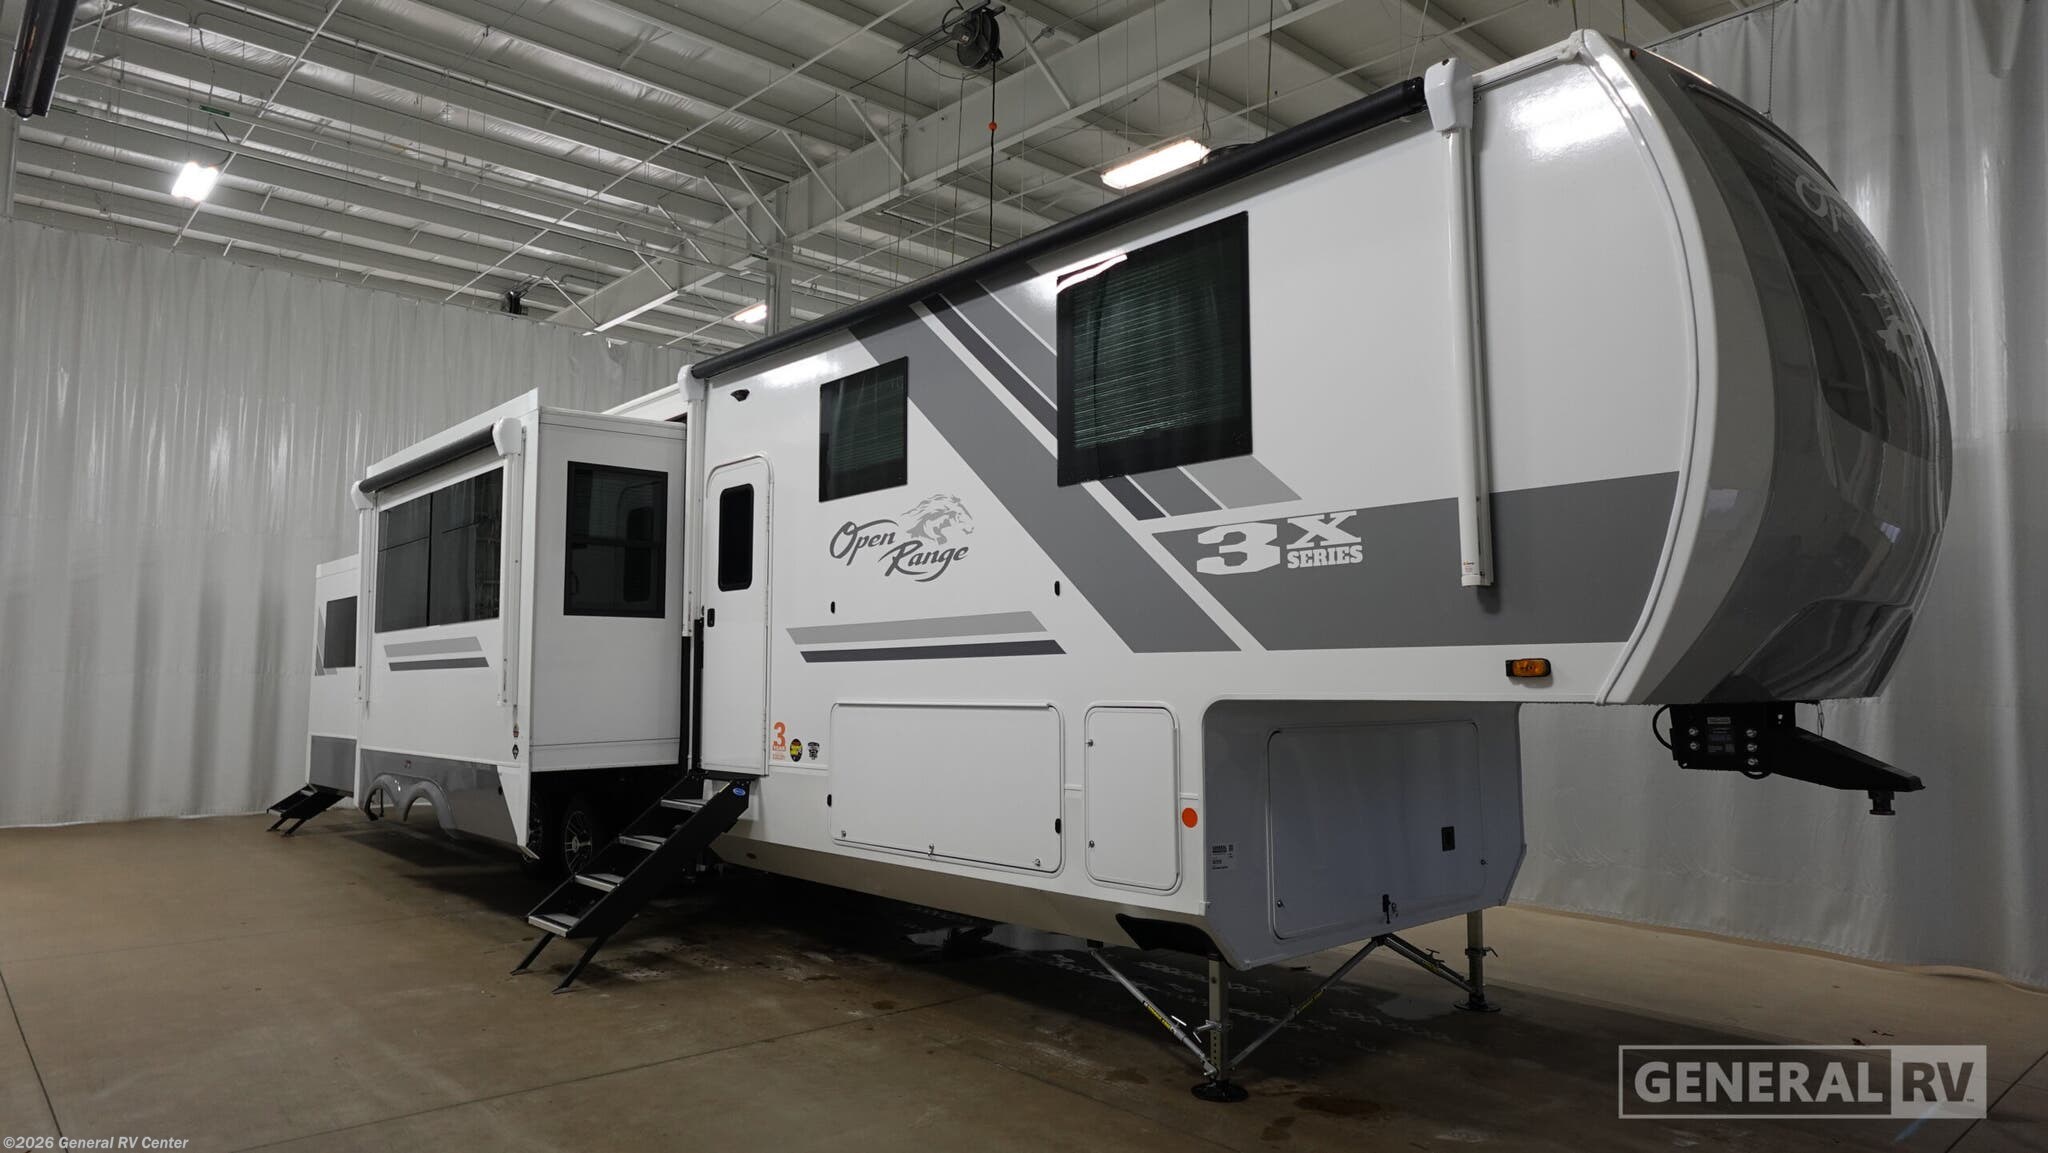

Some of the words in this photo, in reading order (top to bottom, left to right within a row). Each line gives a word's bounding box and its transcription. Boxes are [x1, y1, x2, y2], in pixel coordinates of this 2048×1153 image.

[829, 519, 899, 566] Open
[878, 540, 969, 582] Range
[1287, 544, 1363, 569] SERIES
